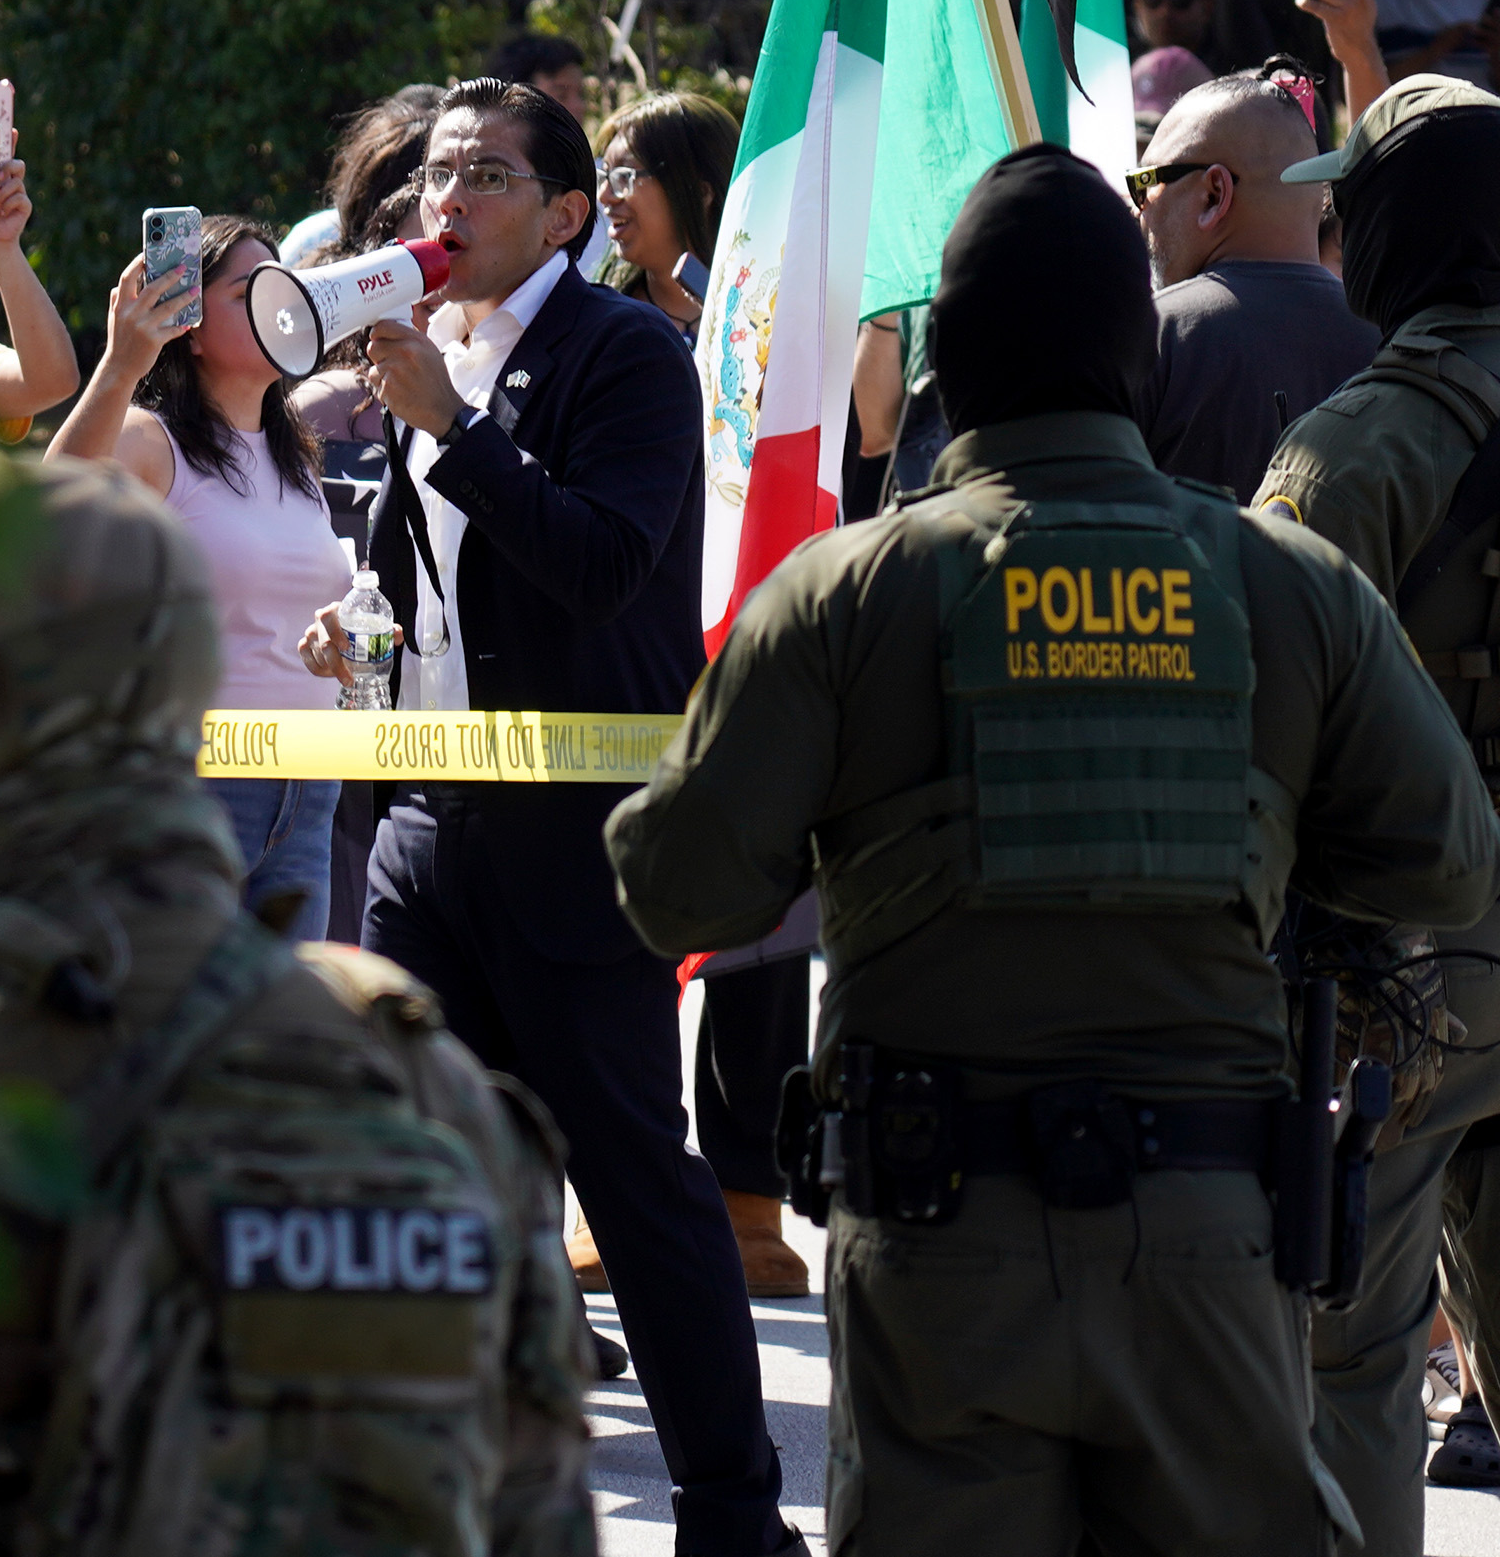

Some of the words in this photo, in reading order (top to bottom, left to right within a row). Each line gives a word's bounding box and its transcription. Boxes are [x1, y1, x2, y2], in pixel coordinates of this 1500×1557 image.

[357, 270, 394, 295] PYLE
[1004, 566, 1195, 636] POLICE
[1008, 641, 1044, 679] U.S.
[1047, 641, 1125, 680] BORDER
[1127, 642, 1196, 682] PATROL
[225, 1207, 491, 1293] POLICE
